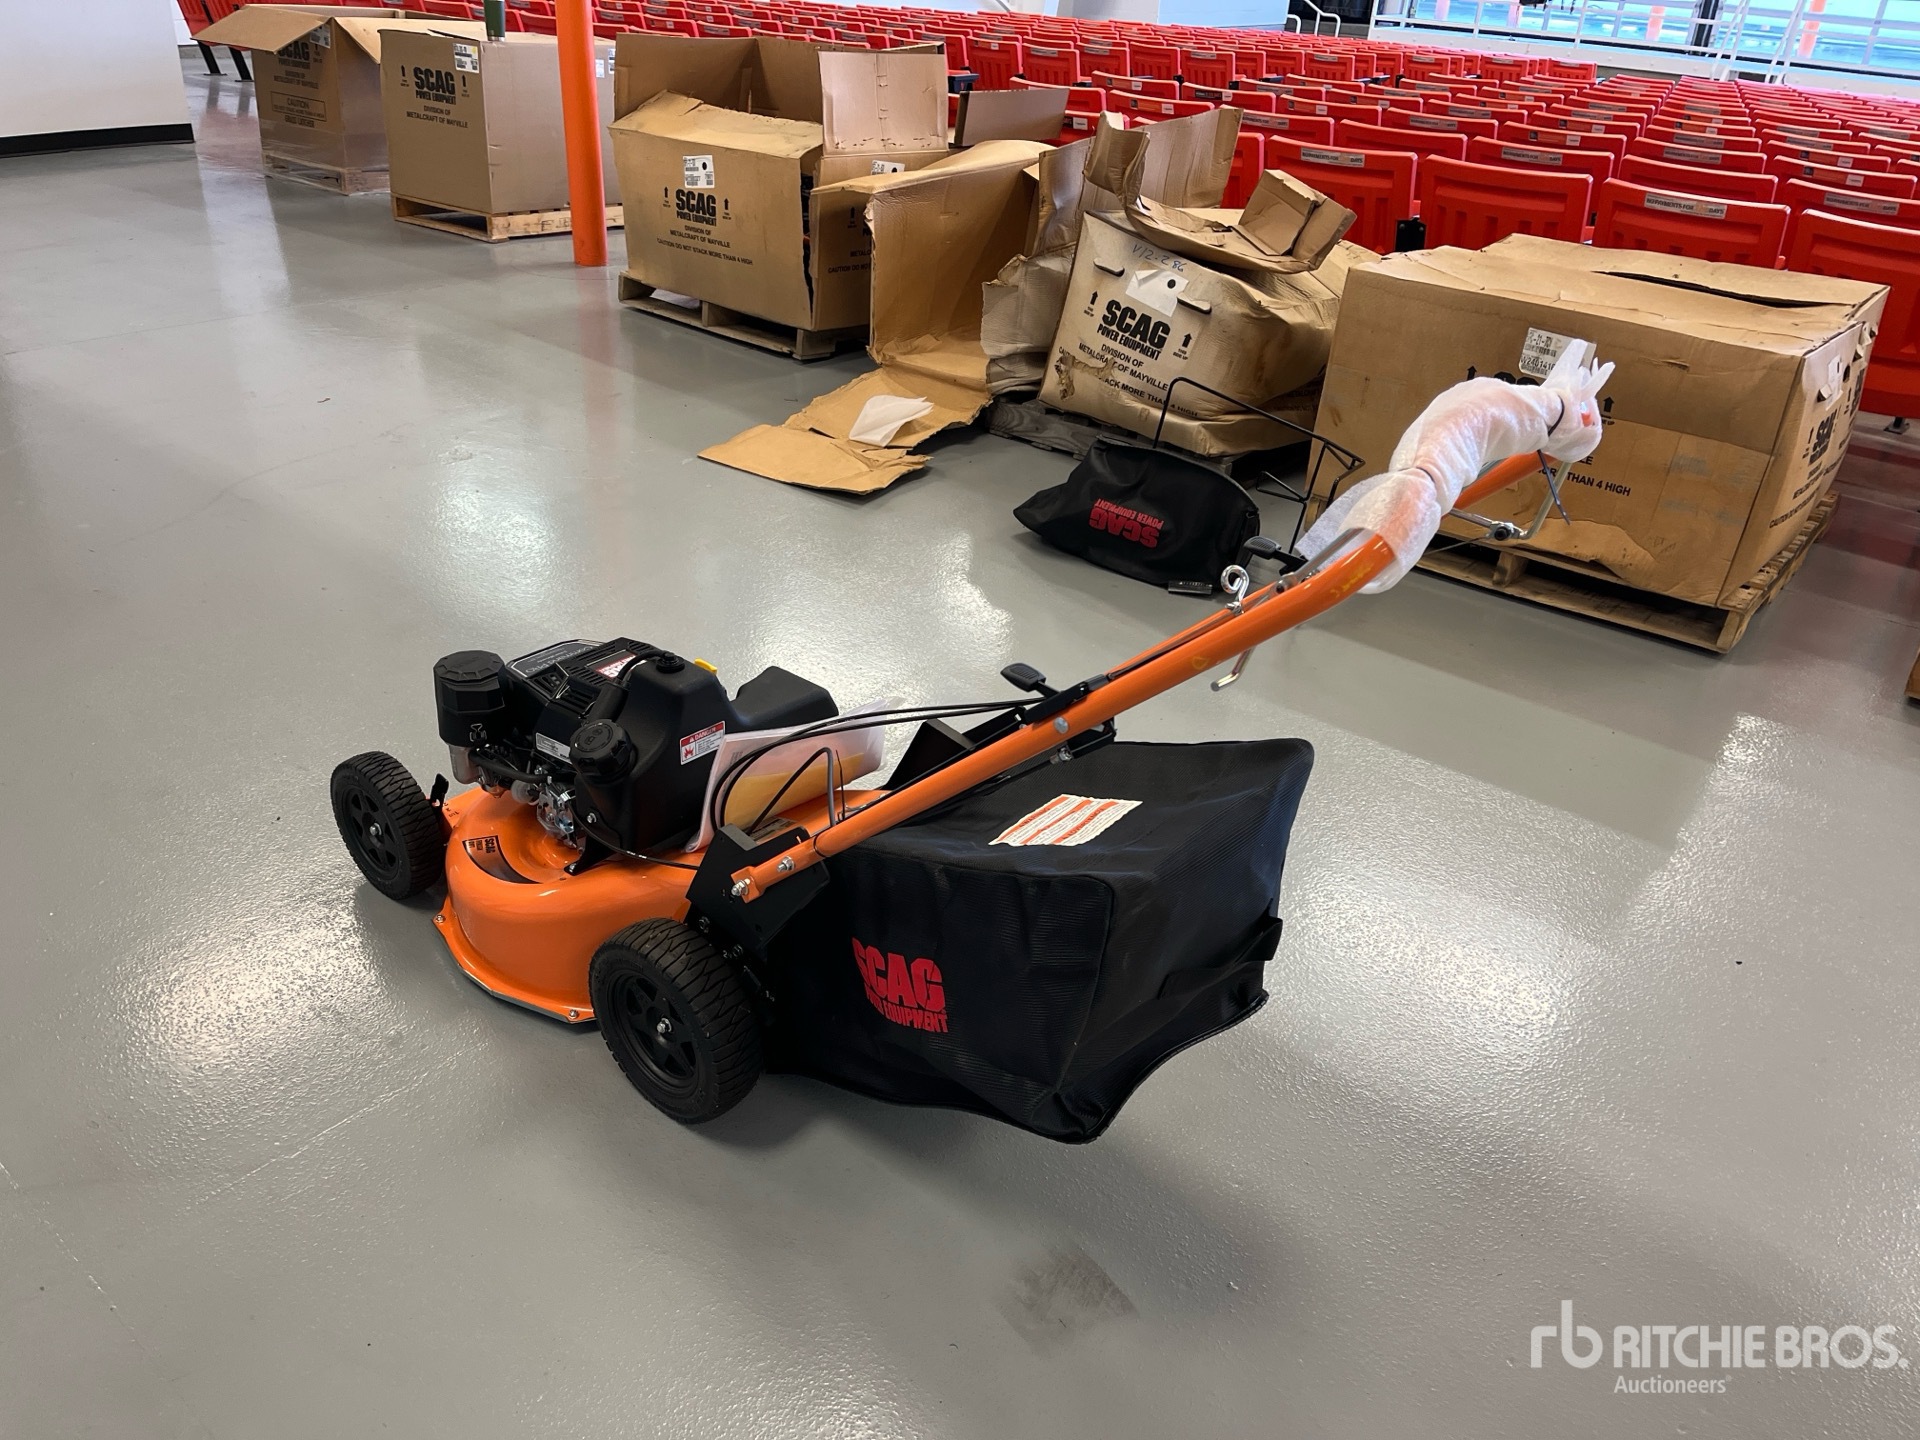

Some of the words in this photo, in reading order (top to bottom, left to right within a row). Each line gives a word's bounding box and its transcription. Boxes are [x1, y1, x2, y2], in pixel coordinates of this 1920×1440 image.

[413, 66, 456, 95] SCAG
[416, 90, 431, 100] POWER
[432, 92, 456, 105] EQUIPMENT
[406, 111, 438, 123] METALCRAFT
[446, 118, 468, 128] MAYVILLE
[424, 105, 444, 115] DIVISION
[676, 188, 716, 217] SCAG
[677, 210, 691, 221] POWER
[692, 213, 716, 226] EQUIPMENT
[684, 225, 704, 235] DIVISION
[657, 238, 675, 248] CAUTION
[693, 246, 707, 255] STACK
[708, 250, 722, 258] MORE
[722, 254, 736, 262] THAN
[670, 229, 699, 241] METALCRAFT
[708, 238, 730, 248] MAYVILLE
[1102, 299, 1171, 350] SCAG
[1097, 323, 1122, 343] POWER
[1119, 334, 1161, 361] EQUIPMENT
[1101, 344, 1132, 363] DIVISION
[1132, 356, 1144, 368] OF
[1118, 364, 1130, 374] OF
[1130, 369, 1169, 391] MAYVILLE
[1121, 384, 1145, 398] MORE
[1567, 472, 1594, 487] THAN
[1596, 480, 1603, 489] 4
[1604, 482, 1631, 496] HIGH
[1094, 498, 1137, 520] EQUIPMENT
[1088, 507, 1159, 548] SCAG
[1136, 513, 1164, 530] POWER
[852, 937, 946, 1012] SCAG
[882, 1000, 948, 1033] EQUIPMENT
